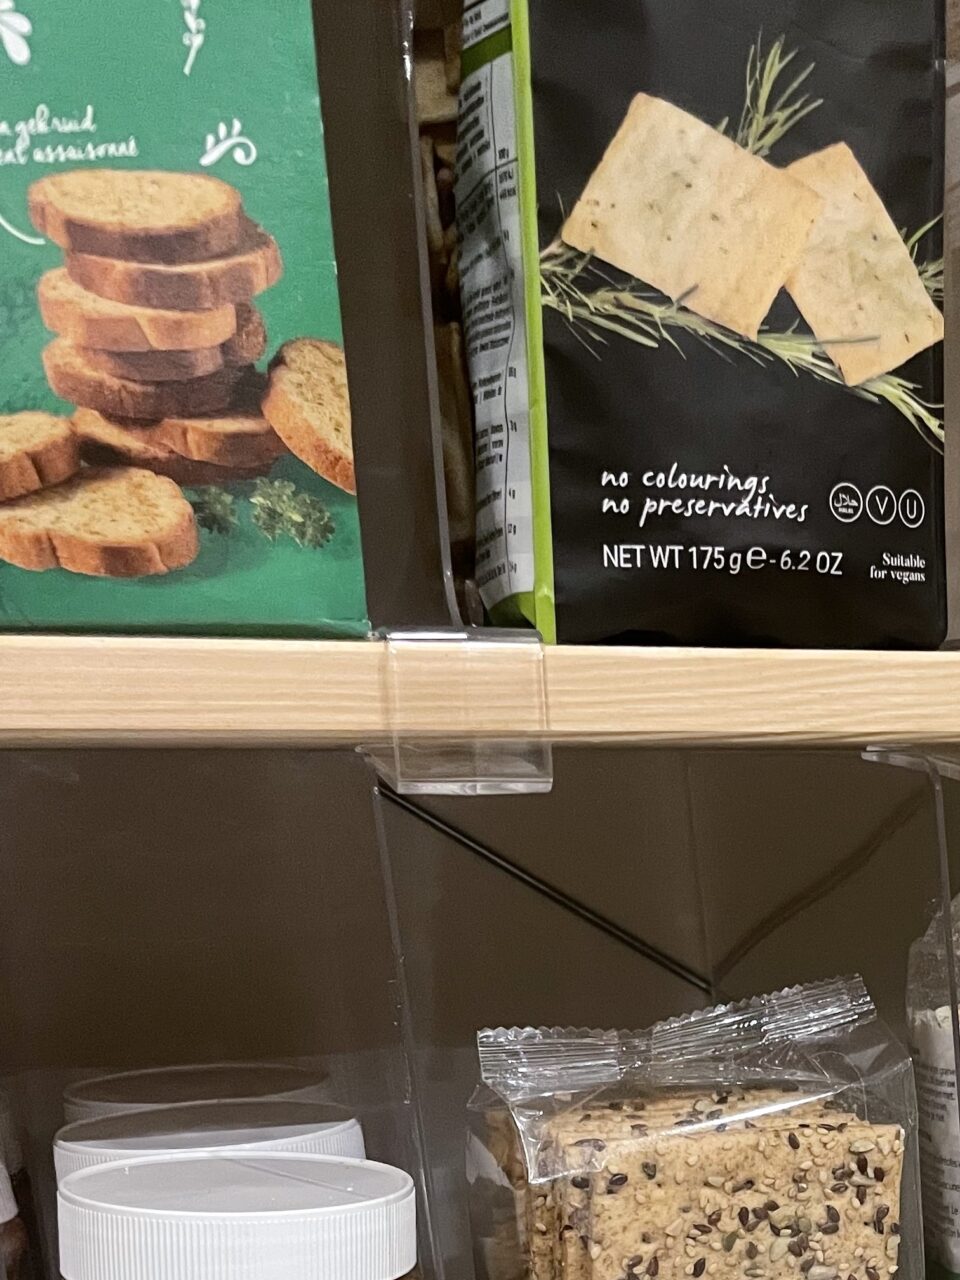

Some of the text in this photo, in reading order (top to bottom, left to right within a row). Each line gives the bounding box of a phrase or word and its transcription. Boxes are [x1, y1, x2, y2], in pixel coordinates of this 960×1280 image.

[601, 462, 769, 503] no colourings
[602, 494, 808, 528] no preservatives
[602, 544, 646, 568] NET
[650, 545, 684, 570] WT
[815, 551, 843, 575] OZ
[870, 565, 926, 585] for vegans
[882, 552, 926, 569] Suitable
